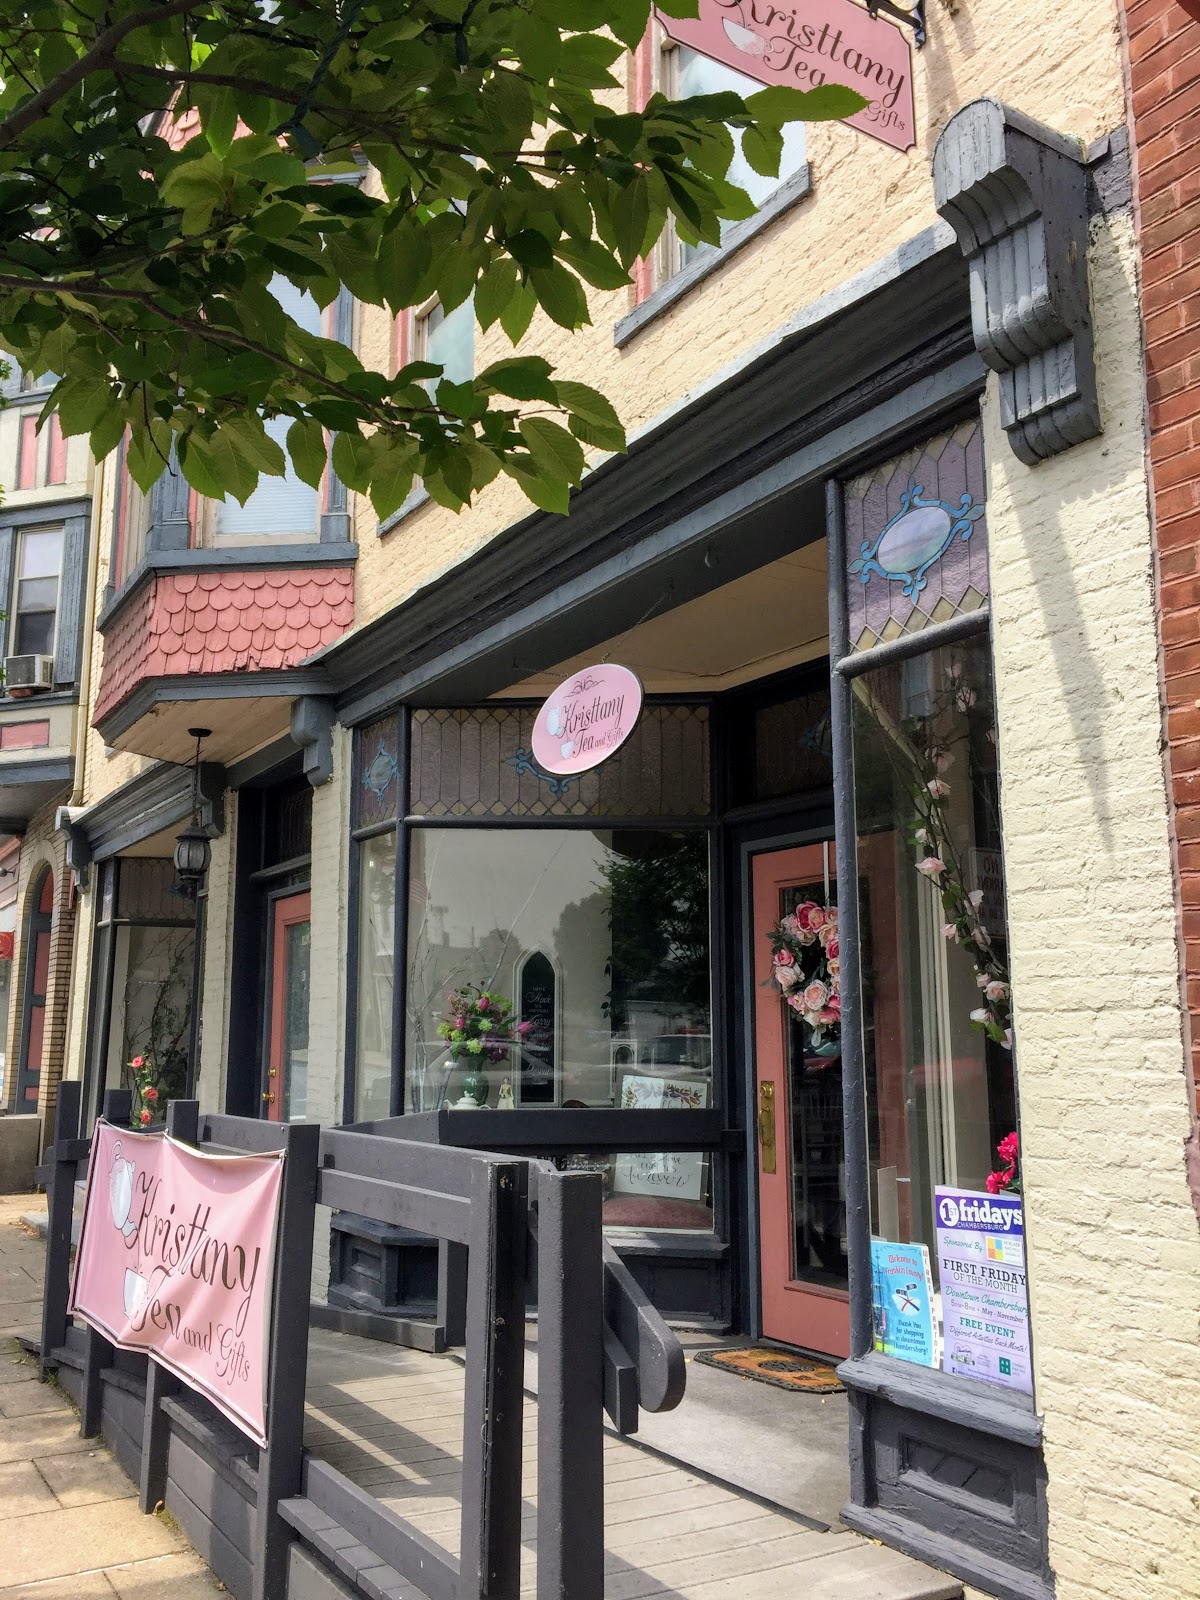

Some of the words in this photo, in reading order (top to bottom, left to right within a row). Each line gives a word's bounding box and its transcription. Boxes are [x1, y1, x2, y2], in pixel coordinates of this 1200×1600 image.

[763, 34, 827, 86] Tea
[864, 101, 905, 130] Gifts
[558, 694, 625, 739] Kristtany
[572, 728, 593, 758] Tea
[595, 732, 607, 748] and
[607, 728, 624, 748] Gifts
[959, 1199, 1023, 1230] fridays
[957, 1221, 1004, 1231] CHAMBERSBURG
[124, 1171, 261, 1338] Kristtany
[943, 1236, 973, 1248] Sponsored
[974, 1242, 982, 1253] By
[888, 1255, 911, 1264] Welcome
[885, 1267, 906, 1276] Franklin
[943, 1259, 977, 1275] FIRST
[981, 1266, 1026, 1285] FRIDAY
[953, 1271, 965, 1282] OF
[966, 1274, 984, 1286] THE
[985, 1279, 1018, 1294] MONTH
[945, 1285, 980, 1303] Downtown
[130, 1265, 181, 1340] Tea
[183, 1322, 213, 1356] and
[215, 1323, 250, 1386] Gifts
[898, 1318, 912, 1329] Thank
[981, 1307, 993, 1318] May
[997, 1311, 1024, 1324] November
[904, 1328, 924, 1339] shopping
[960, 1317, 983, 1331] FREE
[985, 1323, 1016, 1339] EVENT
[901, 1335, 925, 1346] downtown
[949, 1326, 972, 1338] Different
[972, 1332, 994, 1344] Activities
[995, 1338, 1007, 1348] Each
[1007, 1342, 1028, 1354] Month!
